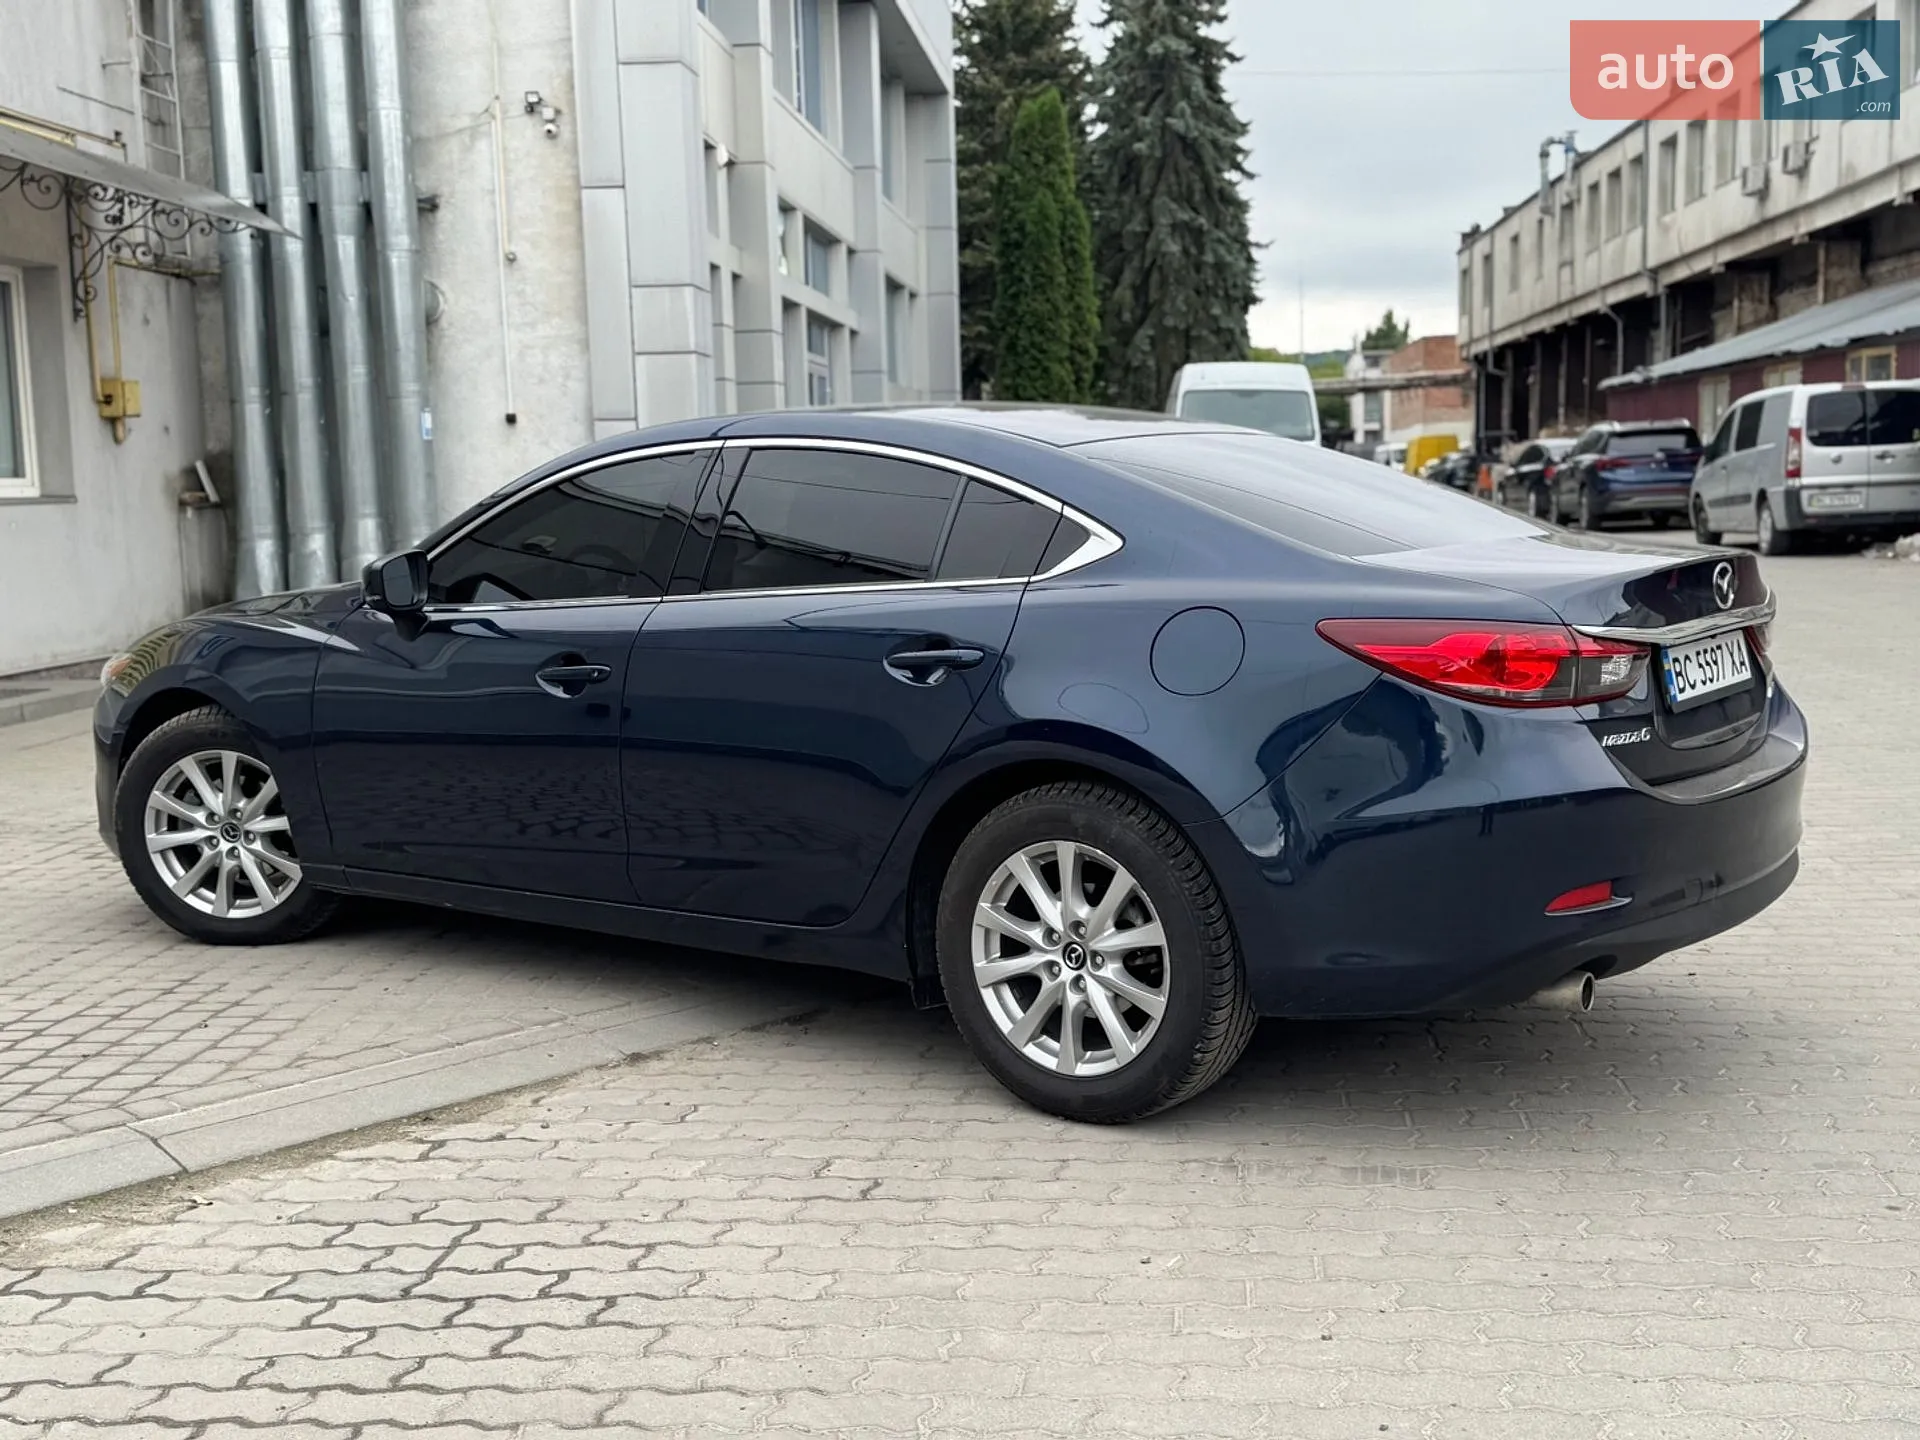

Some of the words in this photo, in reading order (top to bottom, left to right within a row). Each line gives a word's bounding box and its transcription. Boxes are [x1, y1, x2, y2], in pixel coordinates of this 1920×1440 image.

[1672, 654, 1697, 695] BC
[1695, 644, 1726, 686] 5597
[1725, 639, 1748, 677] XA
